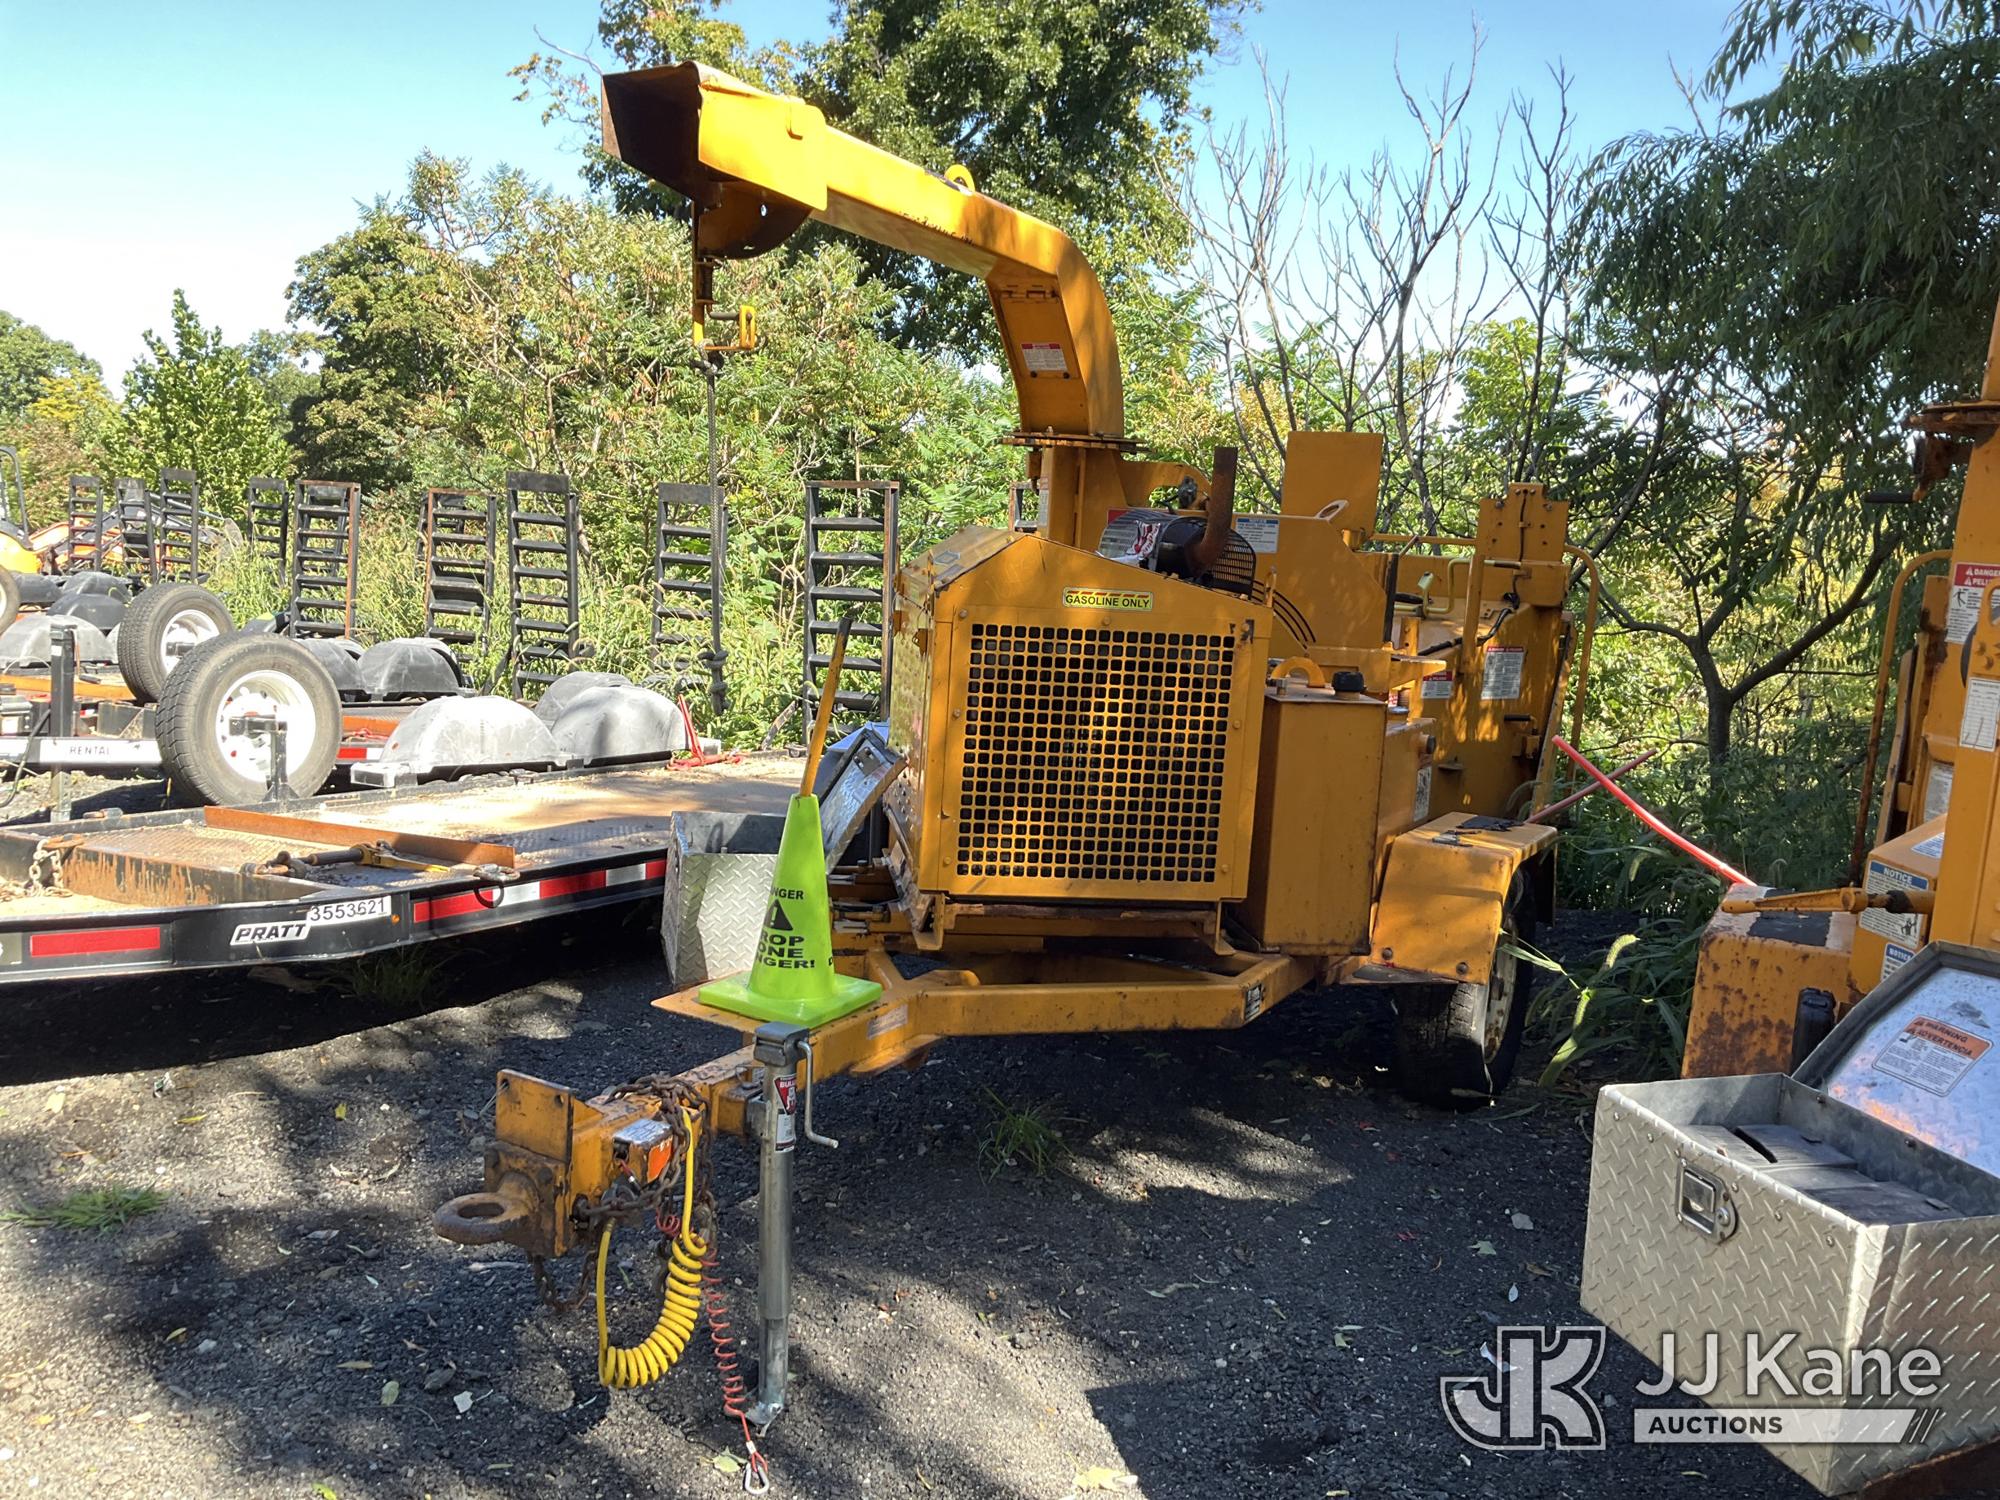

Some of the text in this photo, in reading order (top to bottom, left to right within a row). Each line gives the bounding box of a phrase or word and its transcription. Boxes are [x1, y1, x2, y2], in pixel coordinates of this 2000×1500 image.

[1065, 594, 1150, 608] GASOLINE ONLY
[70, 746, 110, 755] RENTAL
[1883, 867, 1913, 885] NOTICE
[770, 888, 804, 900] NGER
[310, 898, 385, 922] 3553621
[235, 923, 306, 942] PRATT
[761, 930, 805, 946] ROP
[758, 942, 804, 958] ONE
[756, 952, 815, 969] NGER!
